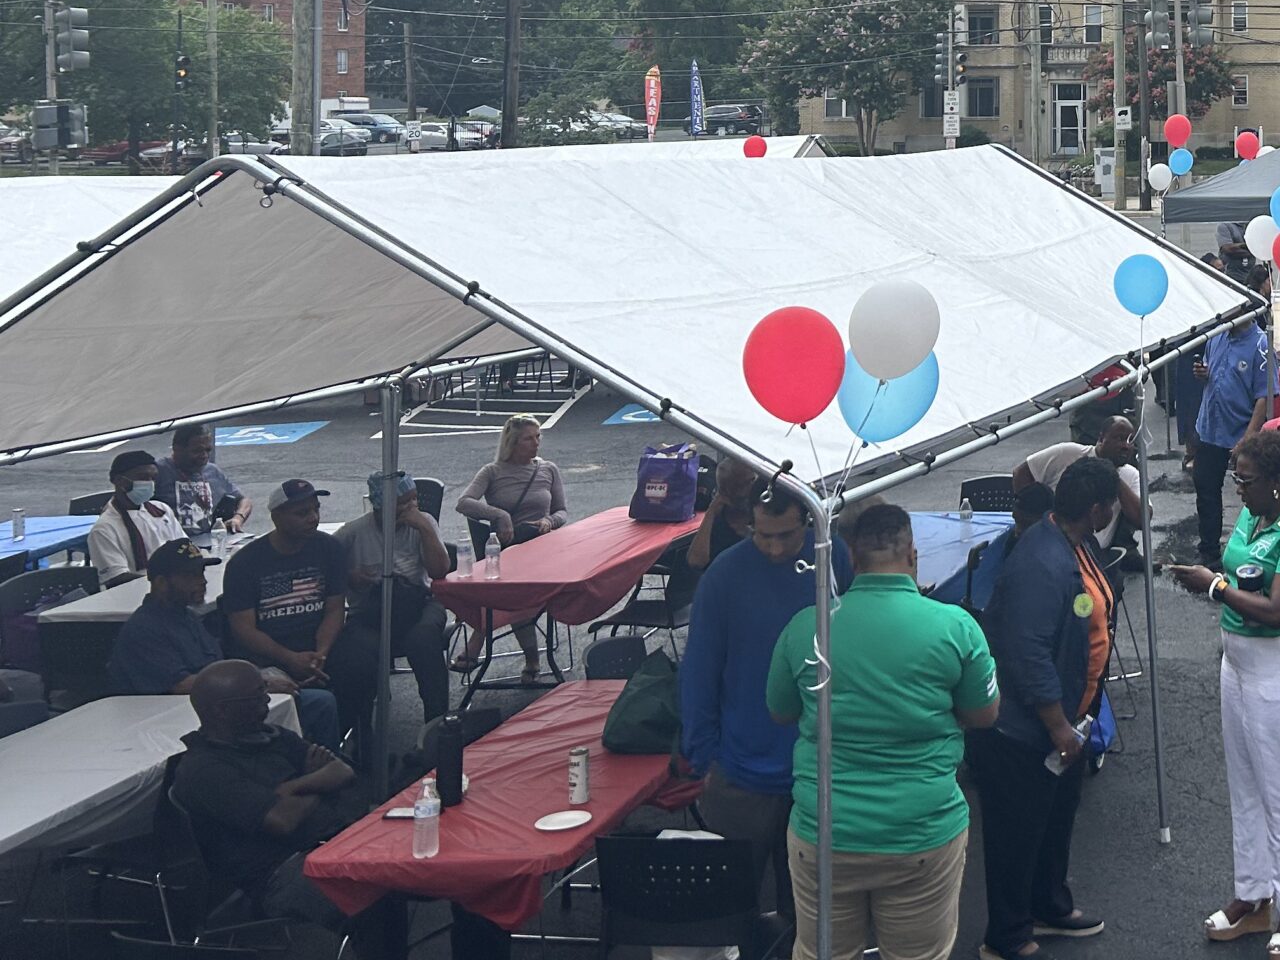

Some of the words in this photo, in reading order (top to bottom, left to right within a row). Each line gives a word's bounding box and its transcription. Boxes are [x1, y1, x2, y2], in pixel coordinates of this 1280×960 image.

[691, 59, 702, 132] APARTMENTS
[408, 130, 421, 138] 20
[259, 601, 324, 621] FREEDOM
